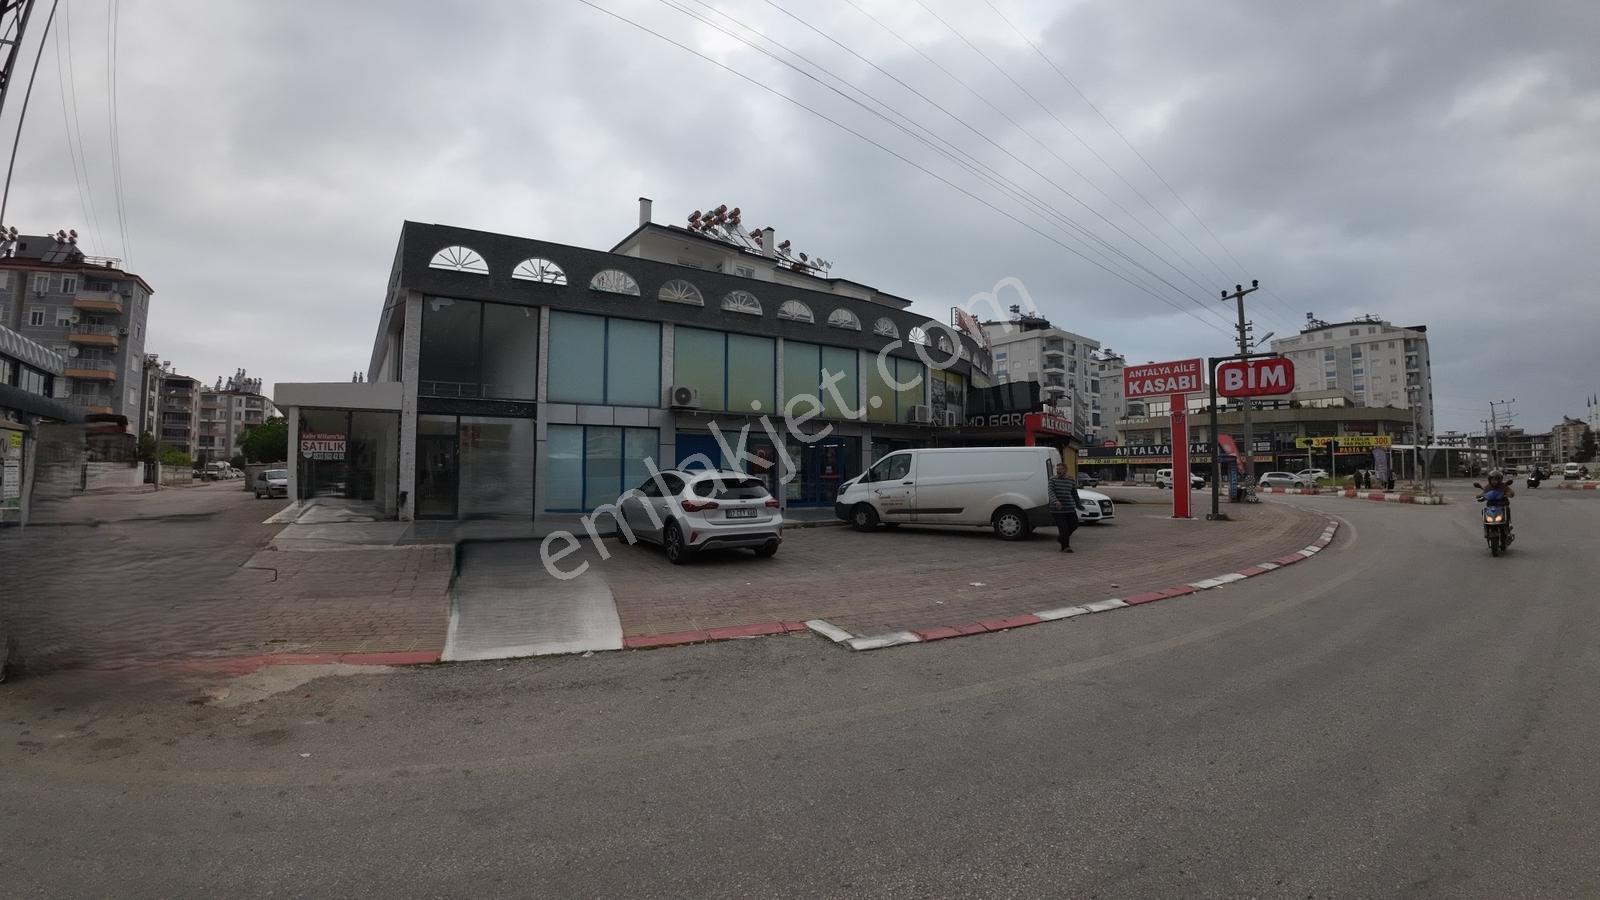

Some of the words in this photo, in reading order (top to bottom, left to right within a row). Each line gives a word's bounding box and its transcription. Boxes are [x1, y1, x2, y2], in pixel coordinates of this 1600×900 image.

[1129, 367, 1170, 379] ANTALYA
[1174, 362, 1196, 374] AİLE
[1225, 361, 1287, 391] BİM
[1128, 375, 1197, 395] KASABI
[303, 442, 344, 451] SATILIK
[1374, 437, 1388, 445] 300
[1115, 445, 1170, 456] ANTALYA
